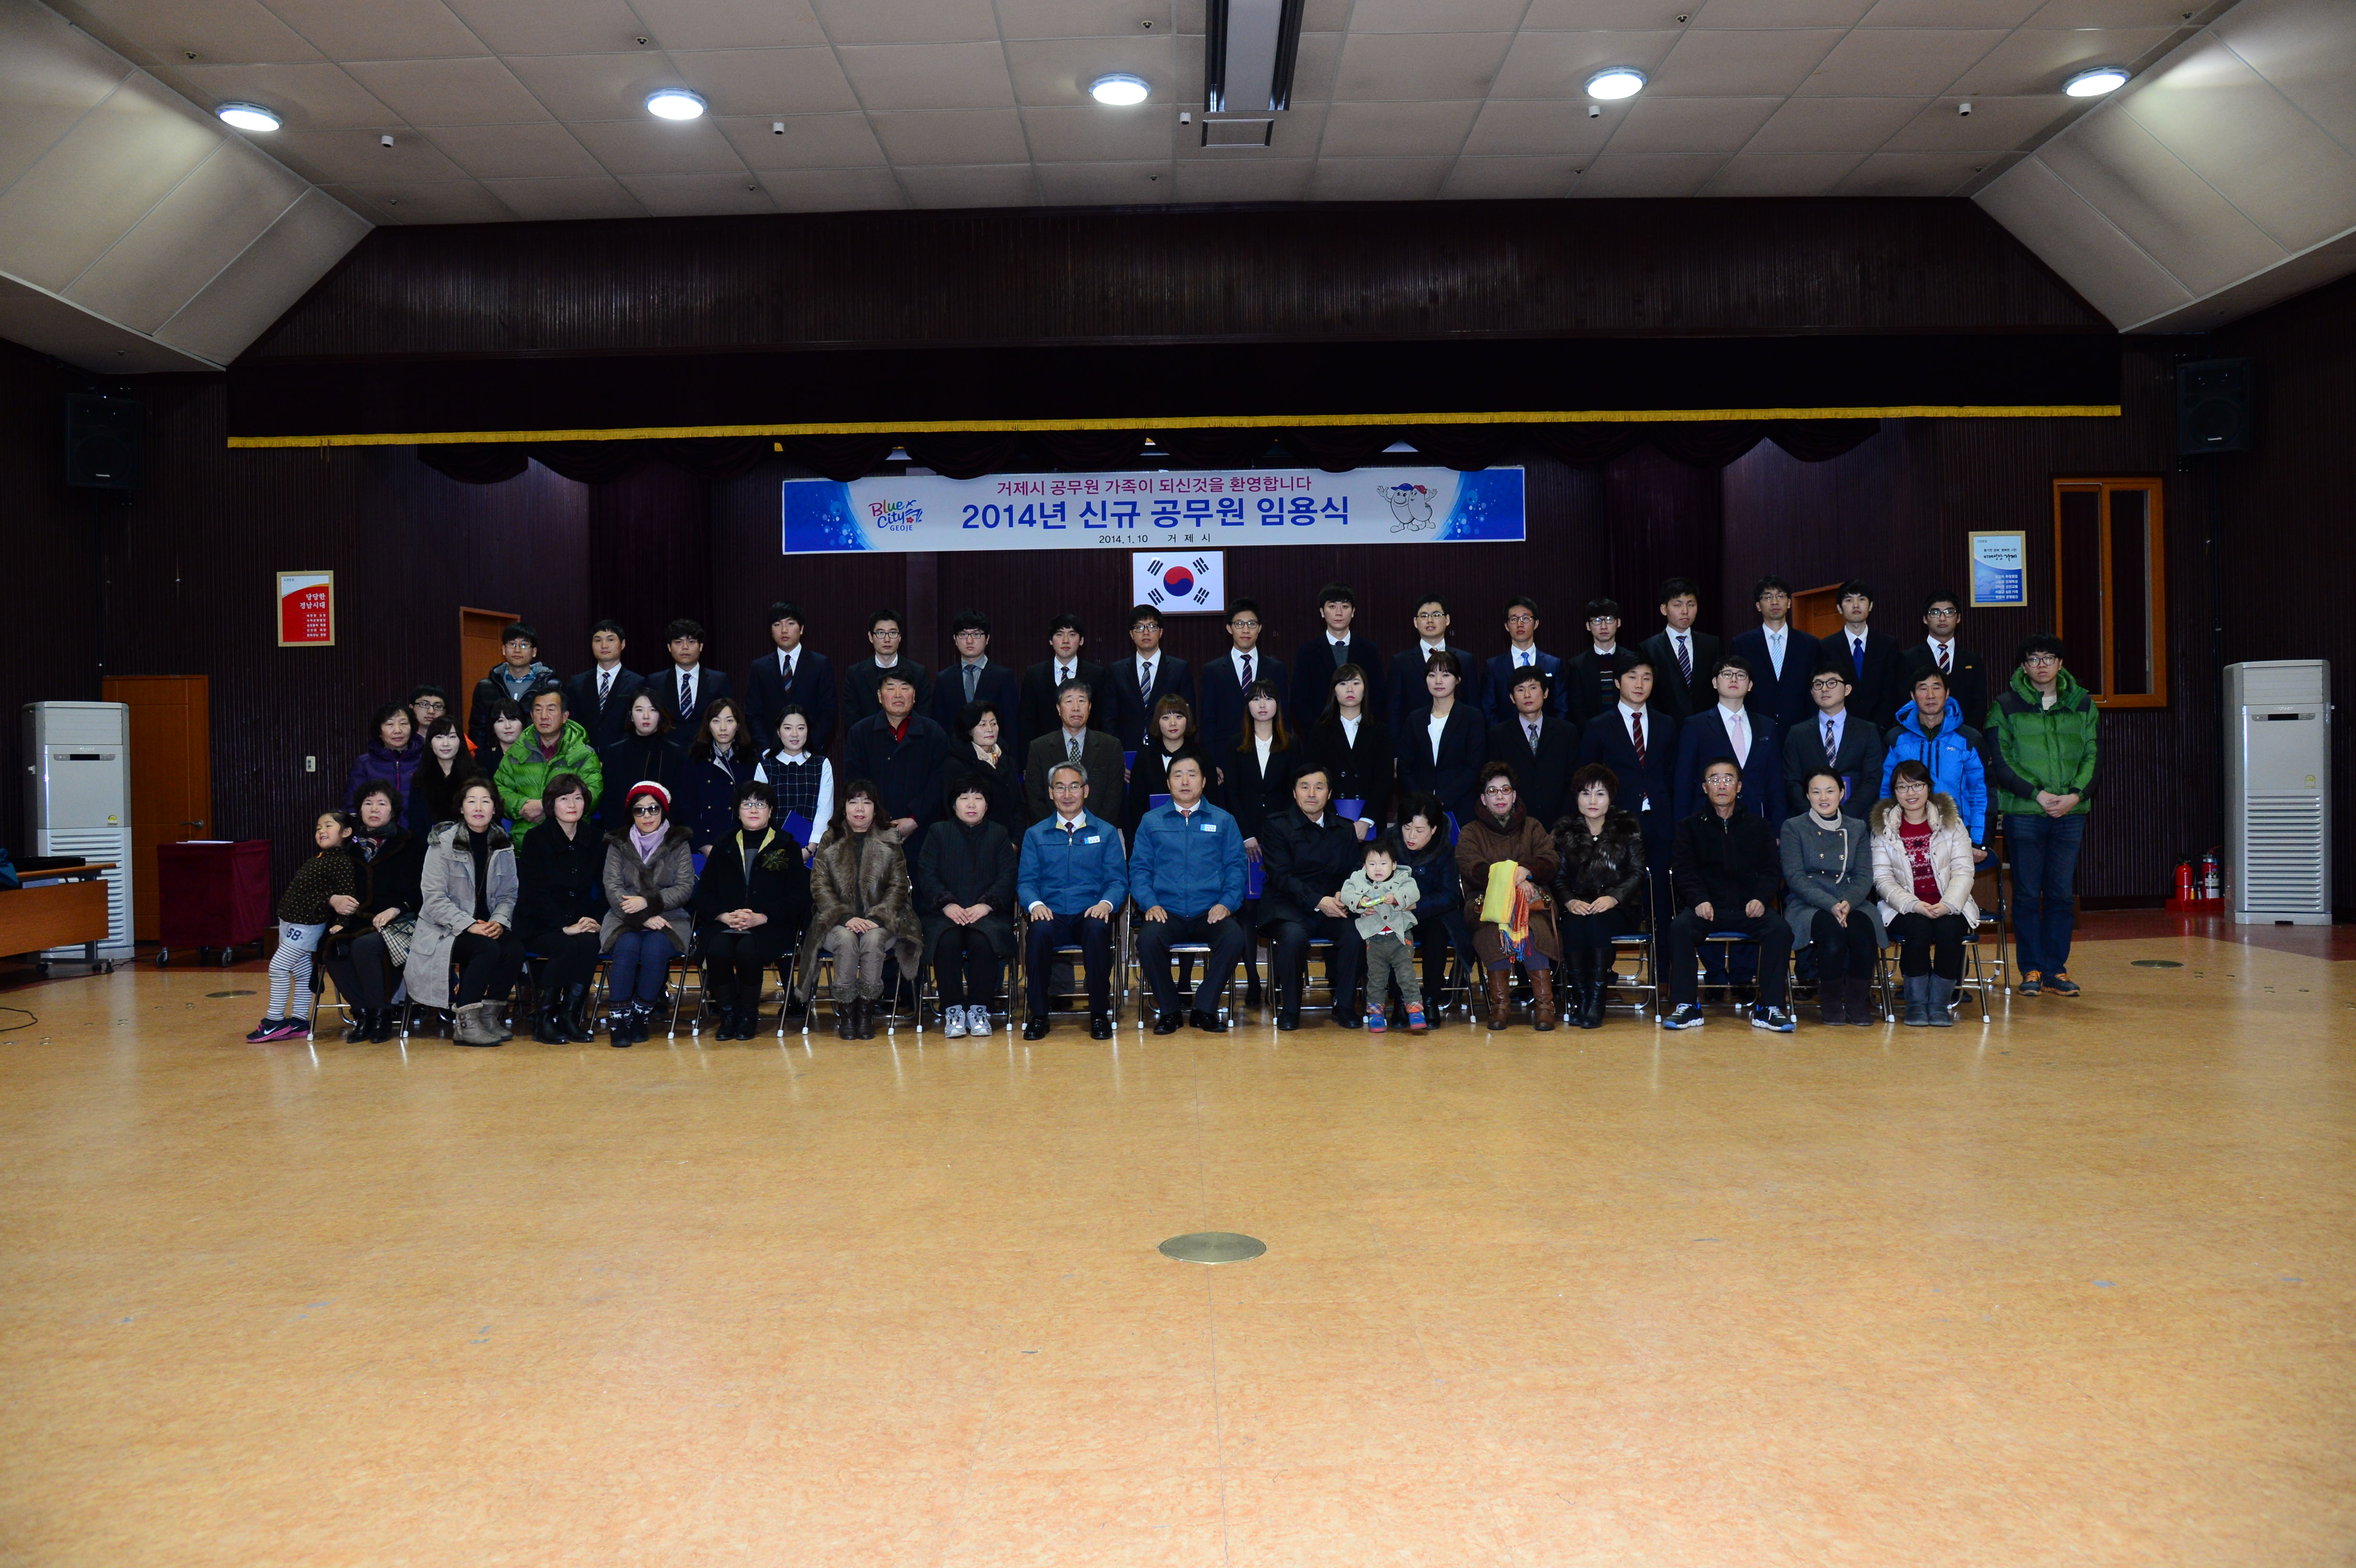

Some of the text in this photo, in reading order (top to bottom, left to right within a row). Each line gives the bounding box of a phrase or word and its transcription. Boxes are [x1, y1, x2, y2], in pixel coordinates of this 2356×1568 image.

[997, 476, 1312, 496] 거제시 공무원 가족이 되신것을 환영합니다
[868, 499, 905, 517] Blue
[962, 496, 1348, 530] 2014년 신규 공무원 임용식
[877, 511, 905, 528] City
[299, 601, 326, 610] 경남시대
[306, 593, 326, 601] 당당한
